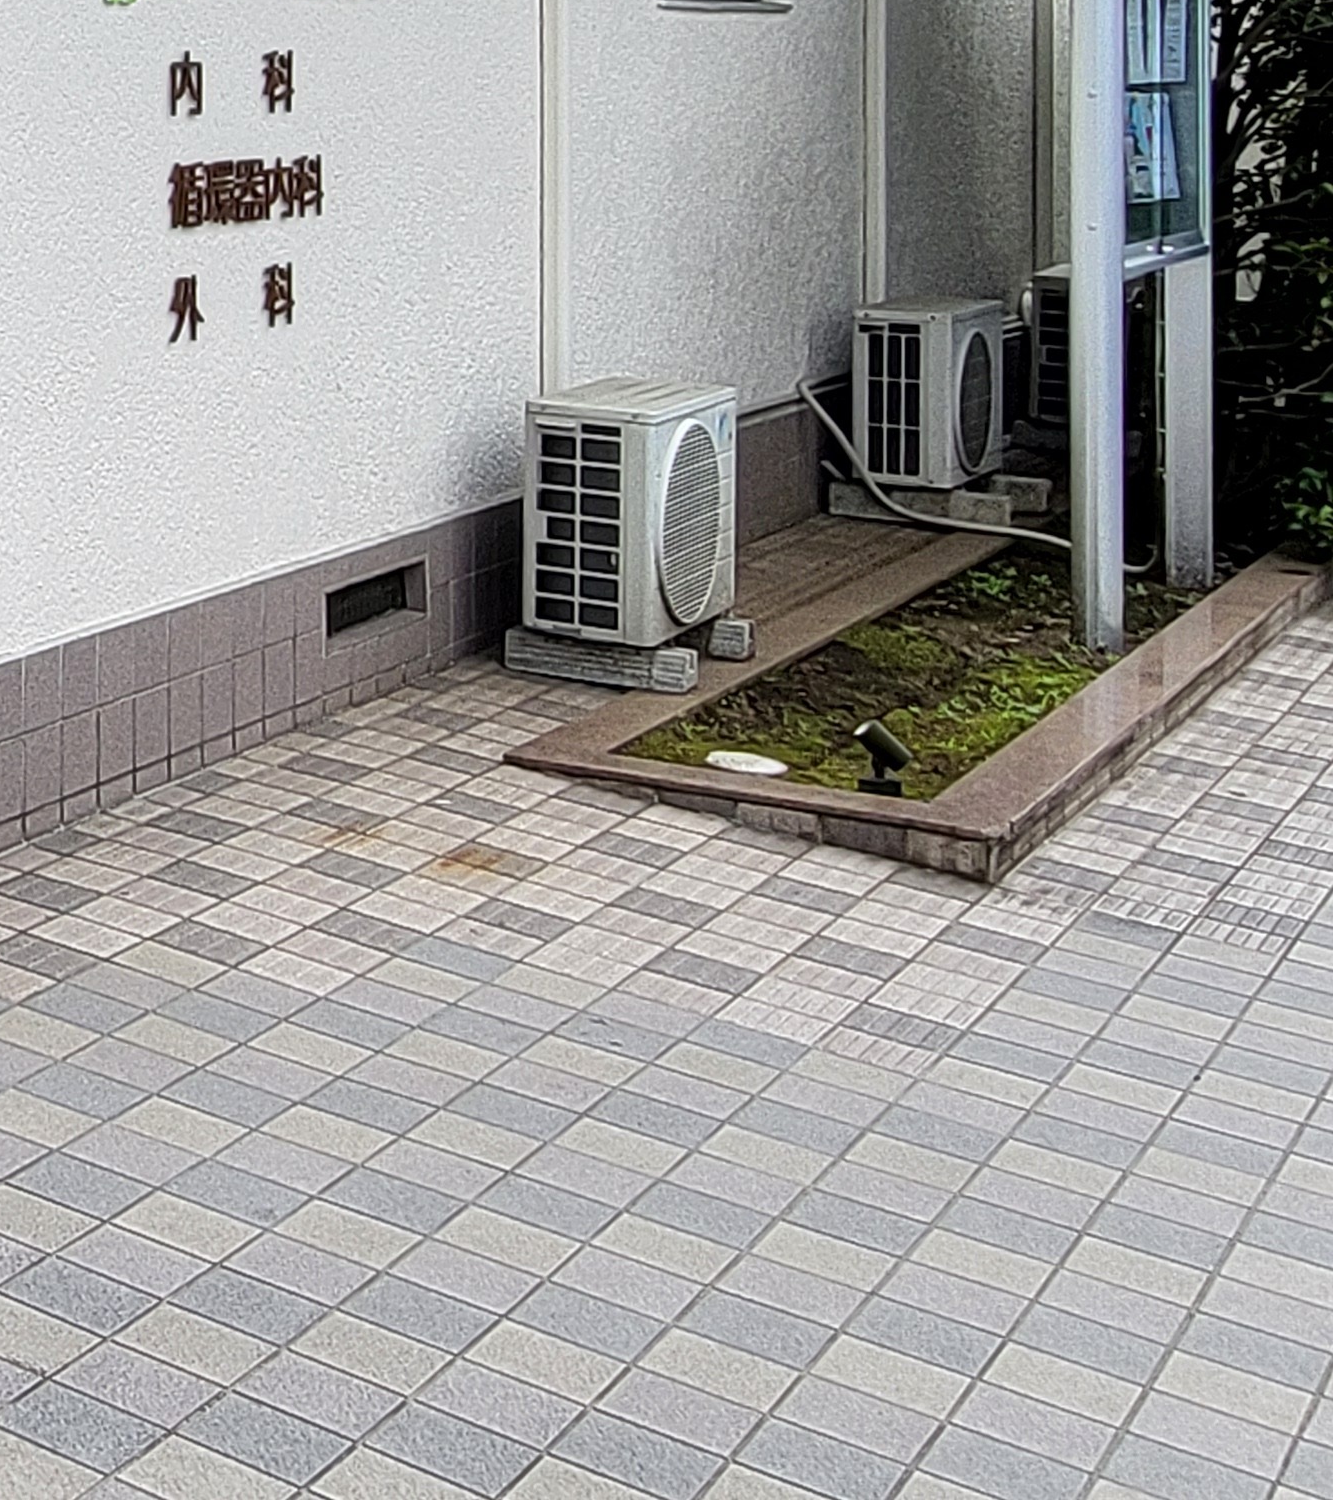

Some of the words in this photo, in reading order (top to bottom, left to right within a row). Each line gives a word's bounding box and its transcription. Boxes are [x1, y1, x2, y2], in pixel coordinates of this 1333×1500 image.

[169, 50, 295, 116] 内科
[167, 154, 323, 229] 循環器内科
[169, 262, 295, 343] 外科
